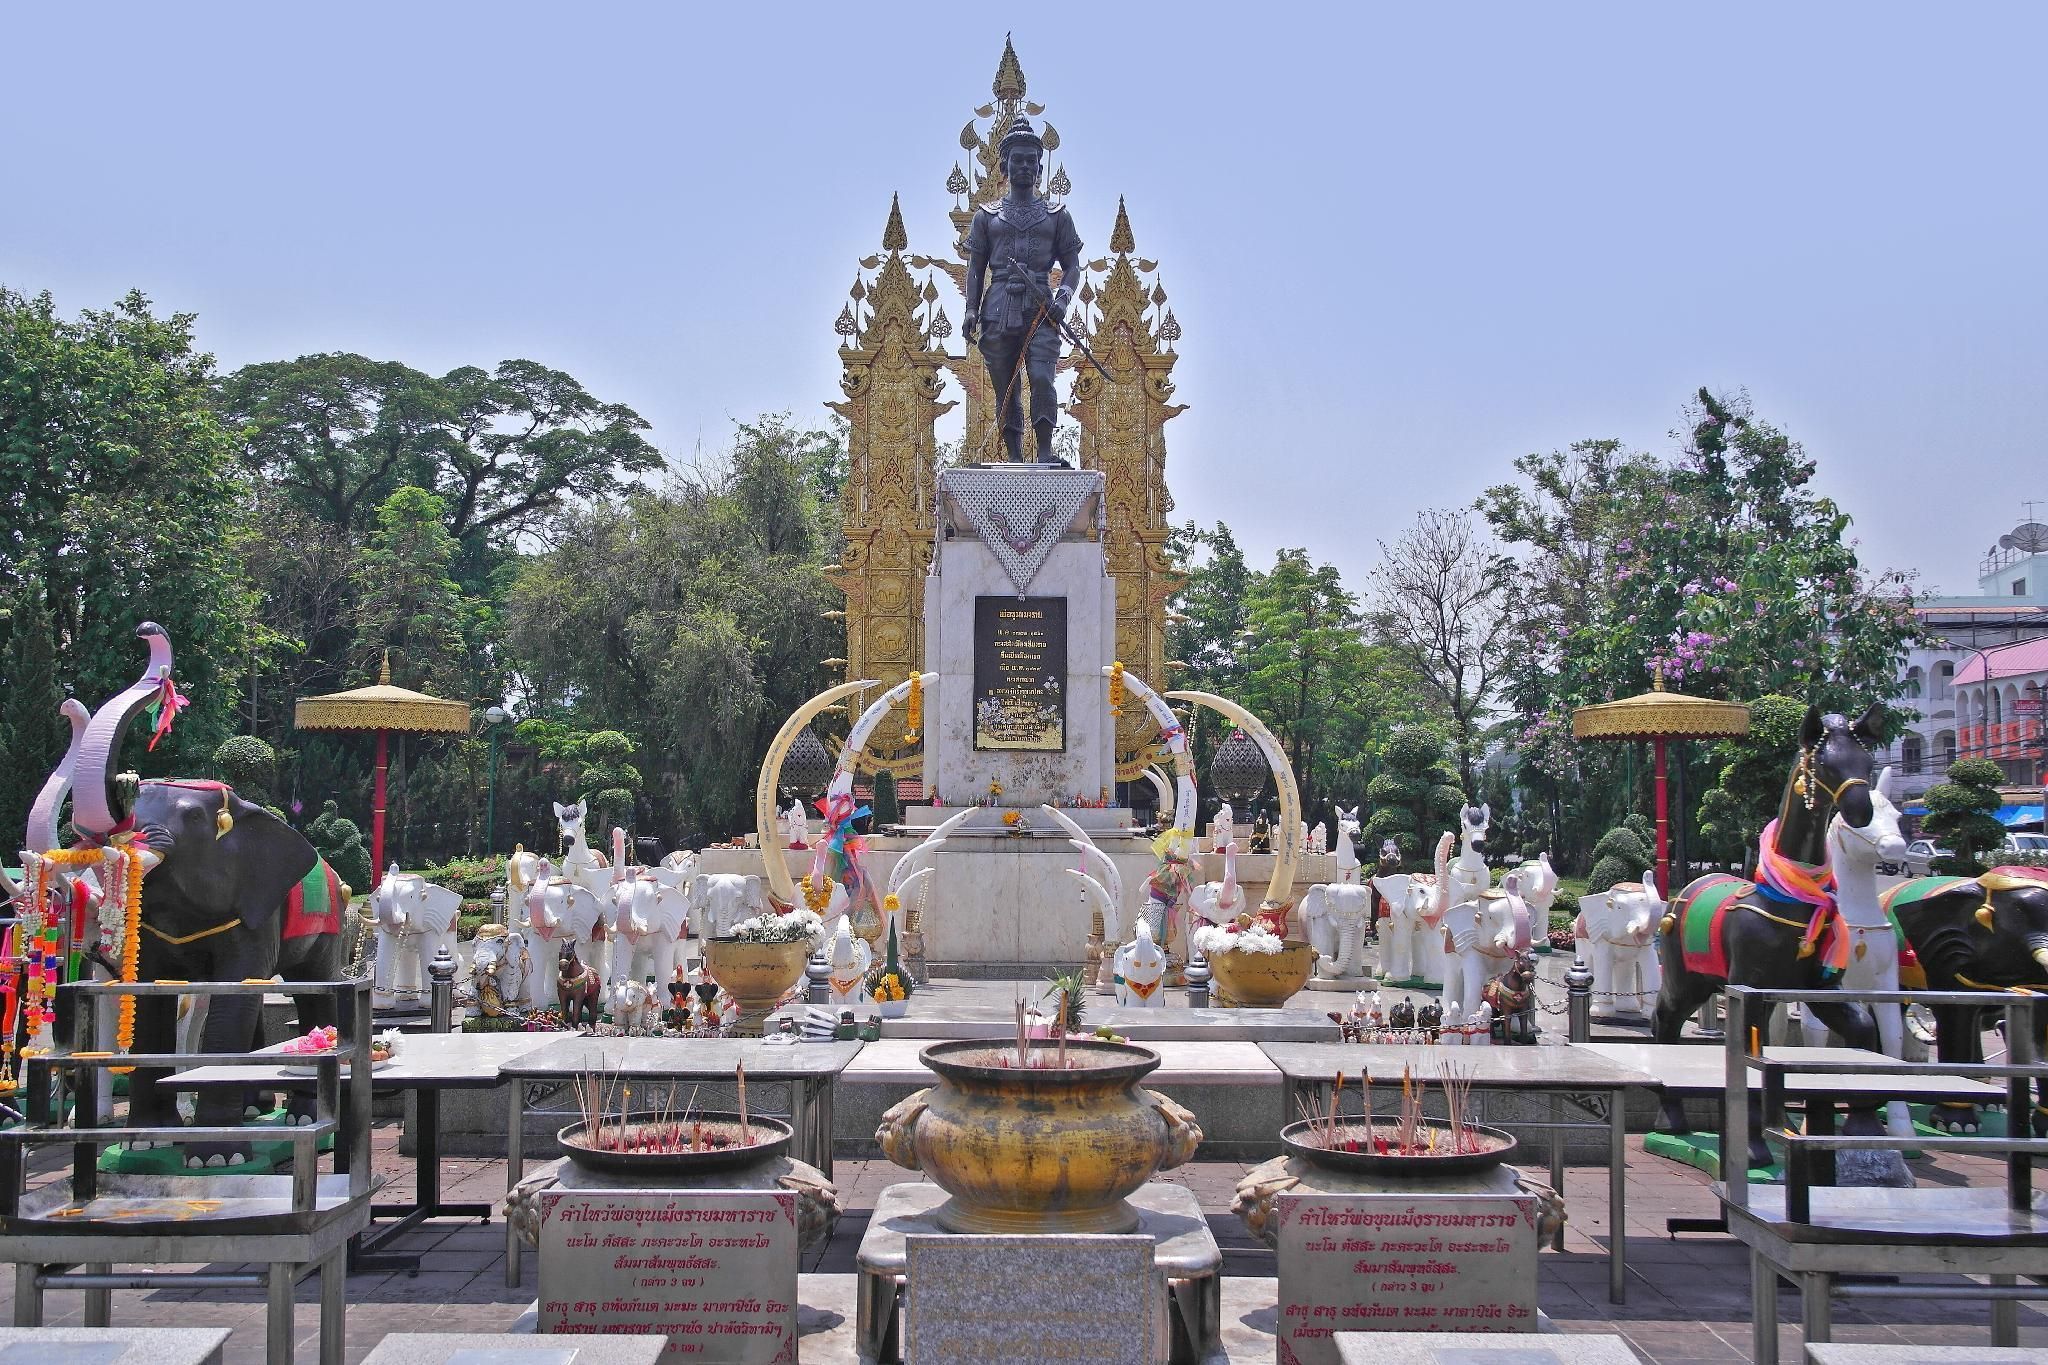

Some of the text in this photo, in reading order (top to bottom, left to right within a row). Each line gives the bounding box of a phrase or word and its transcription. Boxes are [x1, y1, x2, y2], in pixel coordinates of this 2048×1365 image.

[560, 1203, 777, 1228] คำไหว้พ่อขุนเม็งรายมหาราช
[1299, 1207, 1517, 1232] คำไหว้พ่อขุนเม็งรายมหาราช
[567, 1233, 598, 1247] นะโม
[602, 1234, 636, 1247] ตัสสะ
[641, 1233, 703, 1248] ภะคะวะโต
[1306, 1237, 1336, 1252] นะโม
[1341, 1238, 1376, 1251] ตัสสะ
[546, 1301, 568, 1317] สาธุ
[574, 1301, 597, 1317] สาธุ
[664, 1302, 697, 1312] มะมะ
[1286, 1304, 1309, 1320] สาธุ
[1313, 1305, 1337, 1320] สาธุ
[1403, 1305, 1437, 1317] มะมะ
